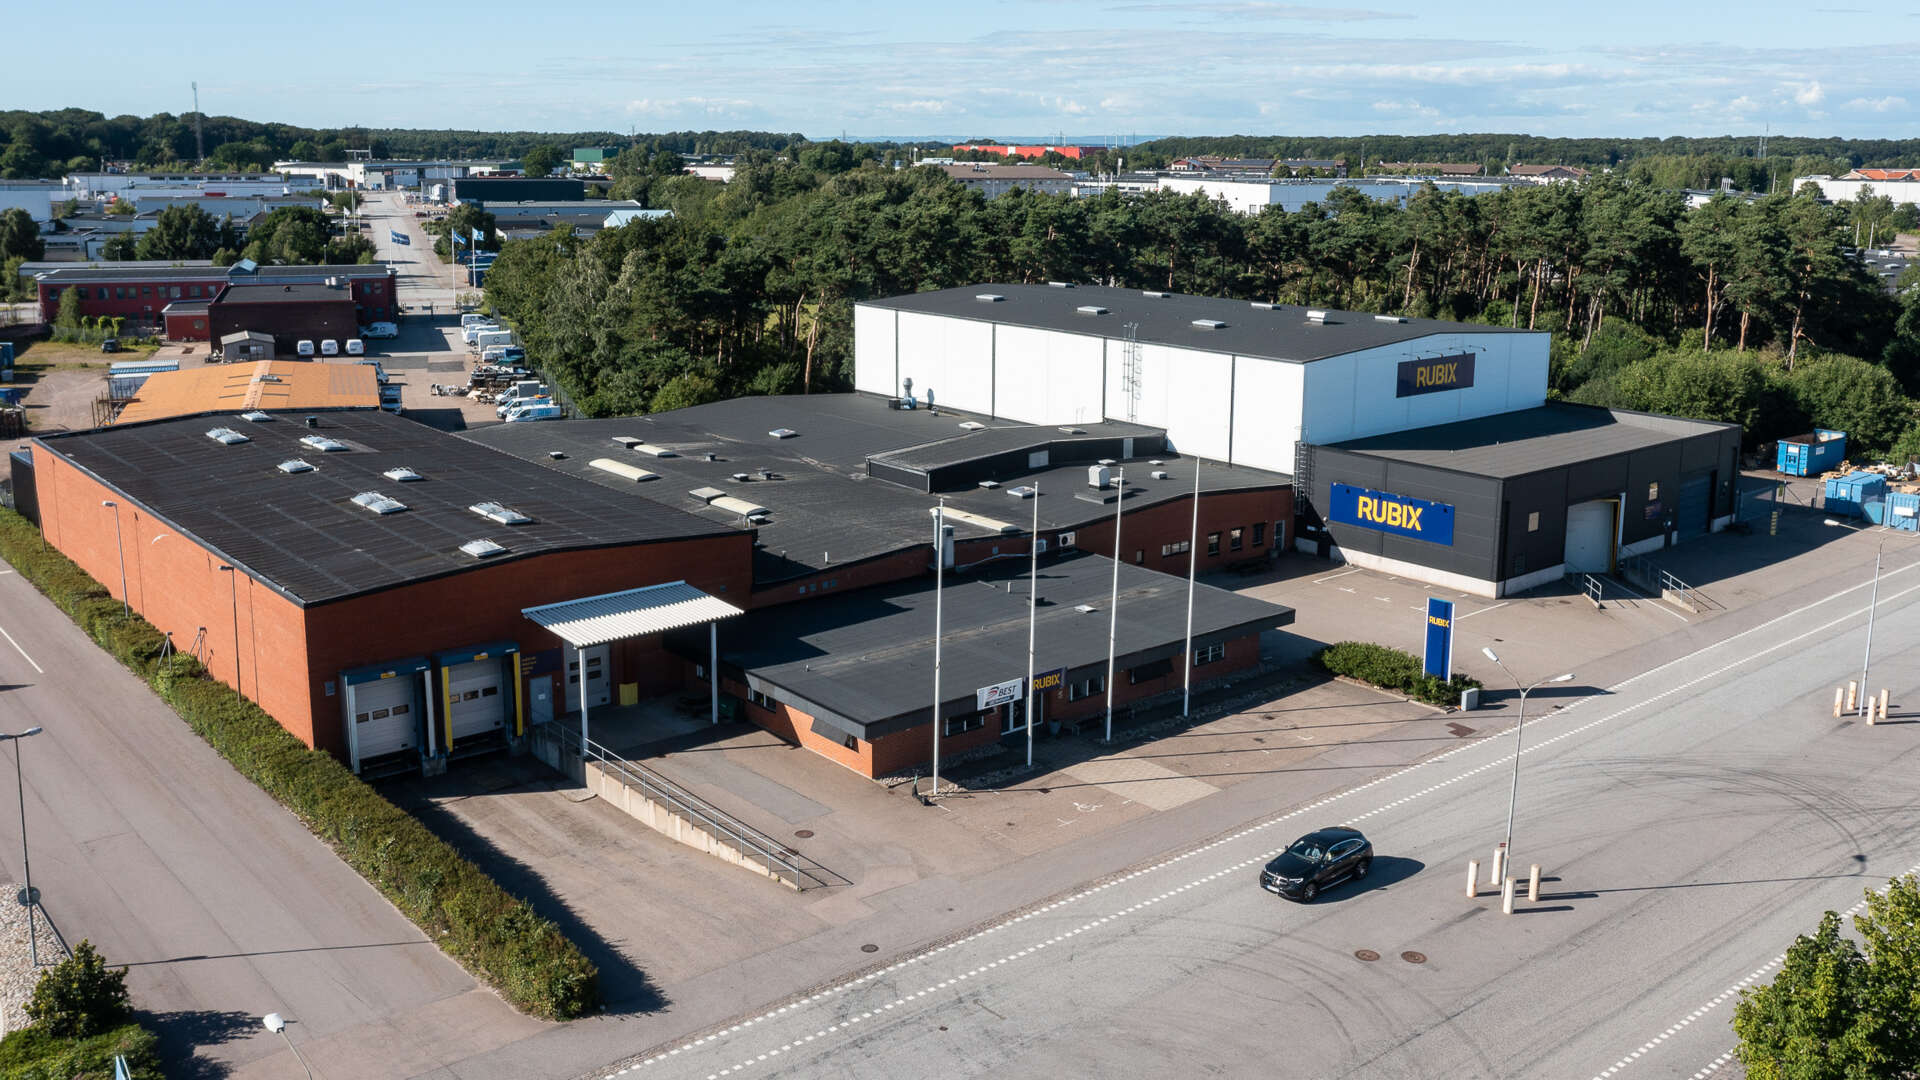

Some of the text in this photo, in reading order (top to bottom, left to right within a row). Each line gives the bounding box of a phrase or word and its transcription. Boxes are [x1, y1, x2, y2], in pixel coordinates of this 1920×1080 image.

[1416, 362, 1458, 388] RUBIX
[1357, 495, 1423, 532] RUBIX
[1429, 616, 1449, 628] RUBIX
[998, 685, 1016, 697] BEST
[1032, 673, 1060, 691] RUBIX
